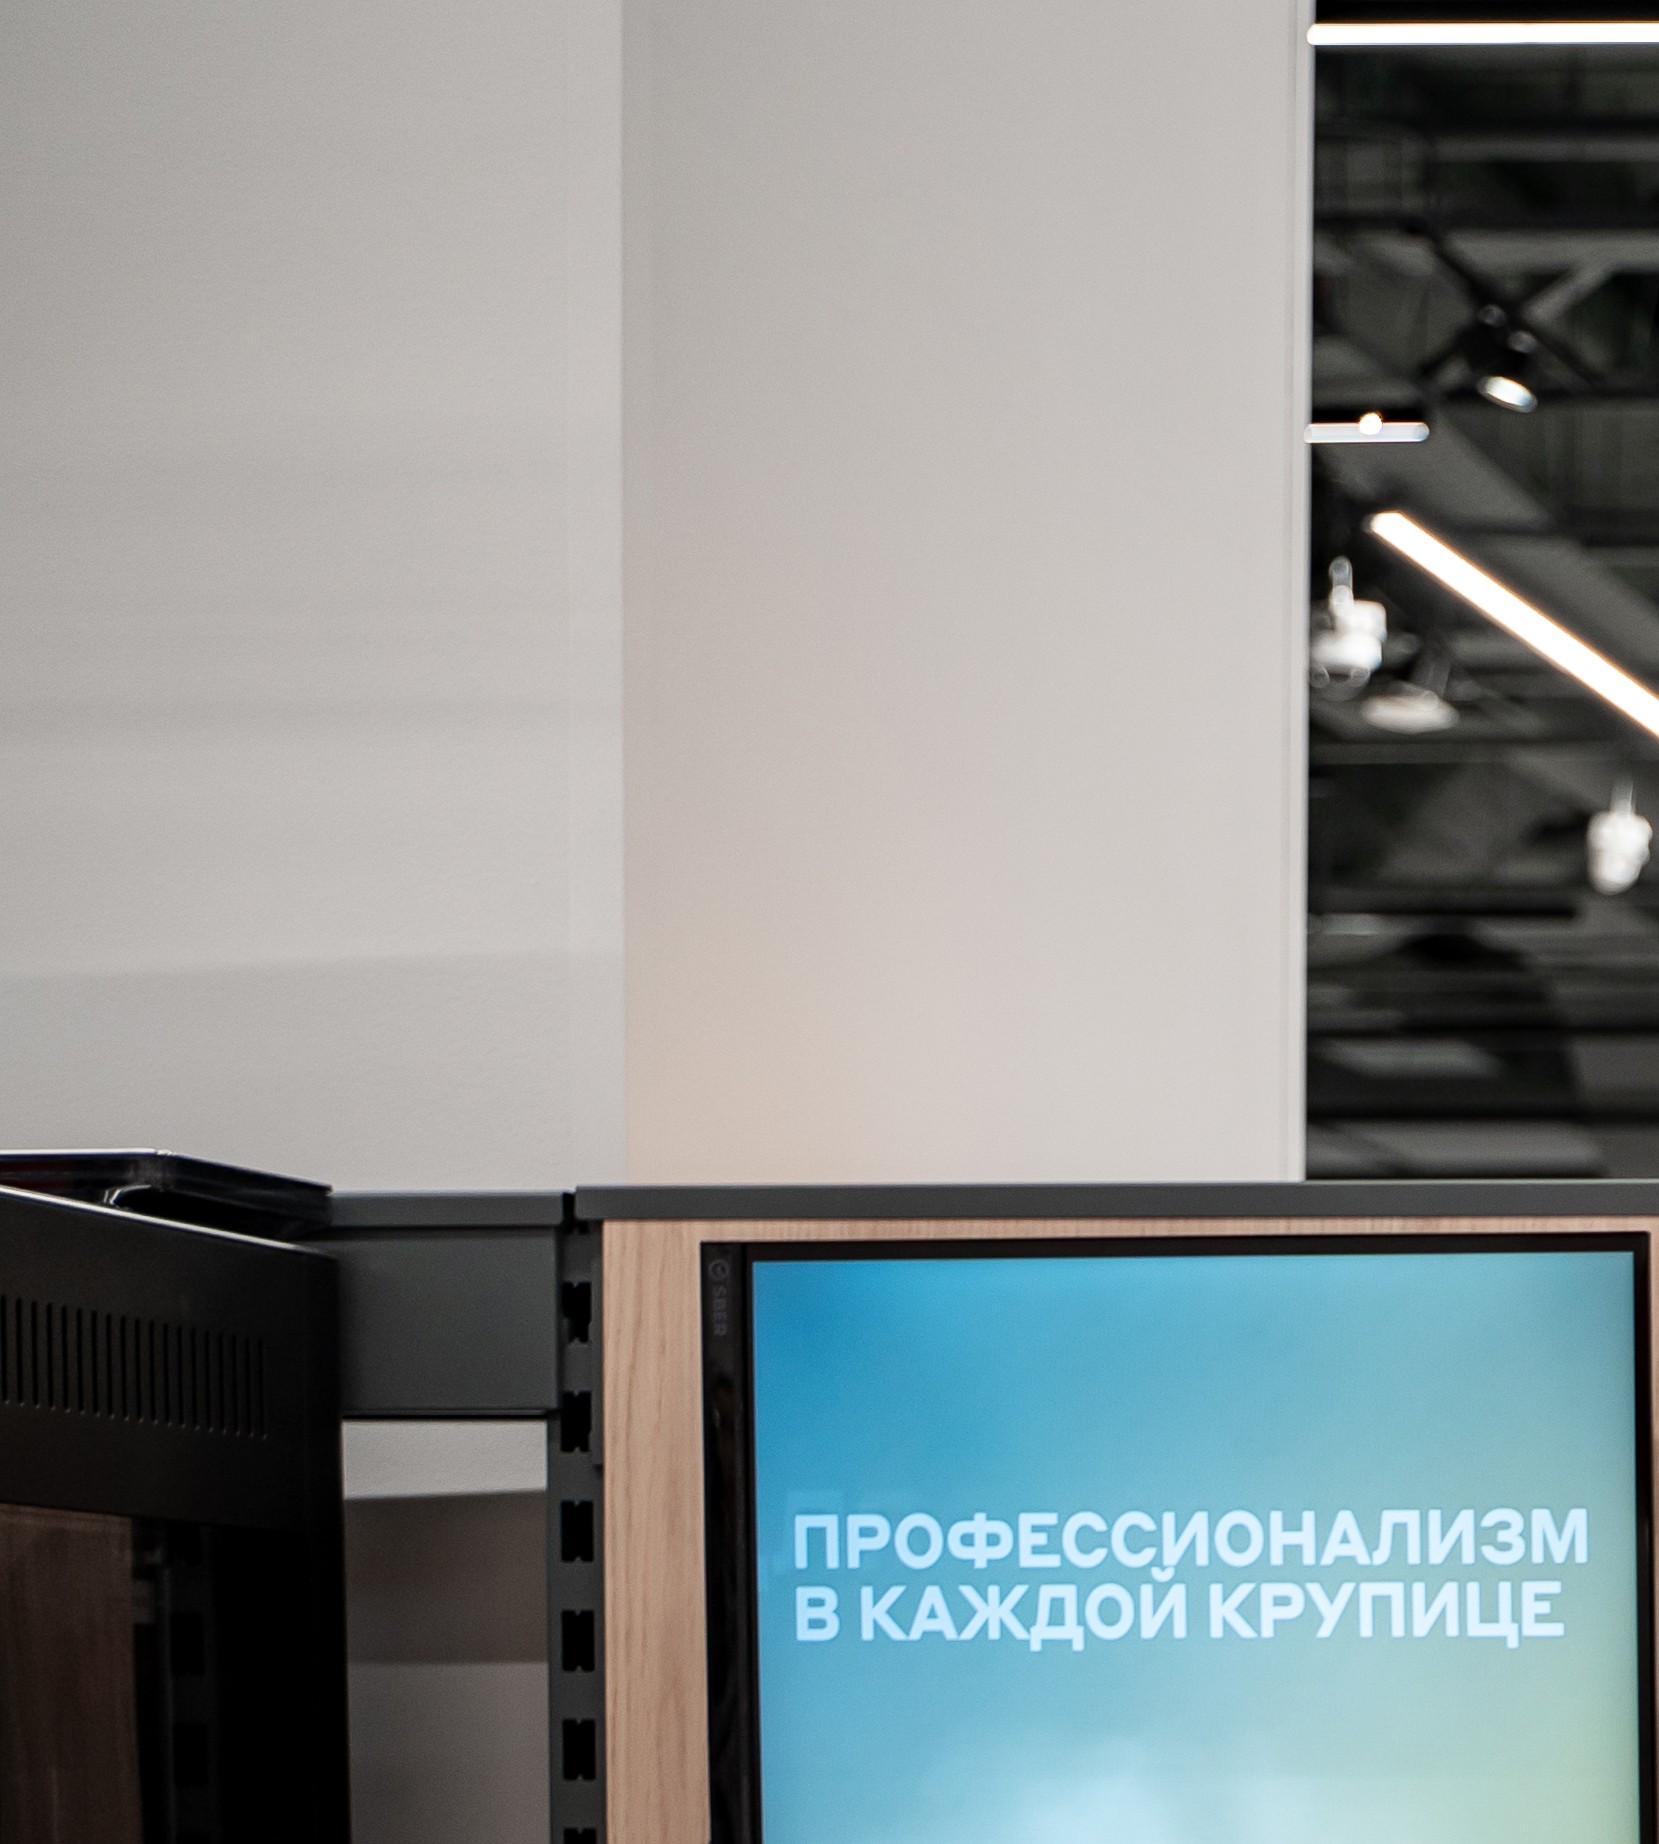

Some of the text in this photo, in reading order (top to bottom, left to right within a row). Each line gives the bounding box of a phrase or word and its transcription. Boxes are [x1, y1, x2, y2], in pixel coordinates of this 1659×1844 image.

[794, 1507, 1590, 1571] ПРОФЕССИОНАЛИЗМ
[796, 1567, 1565, 1652] В КАЖДОЙ КРУПИЦЕ
